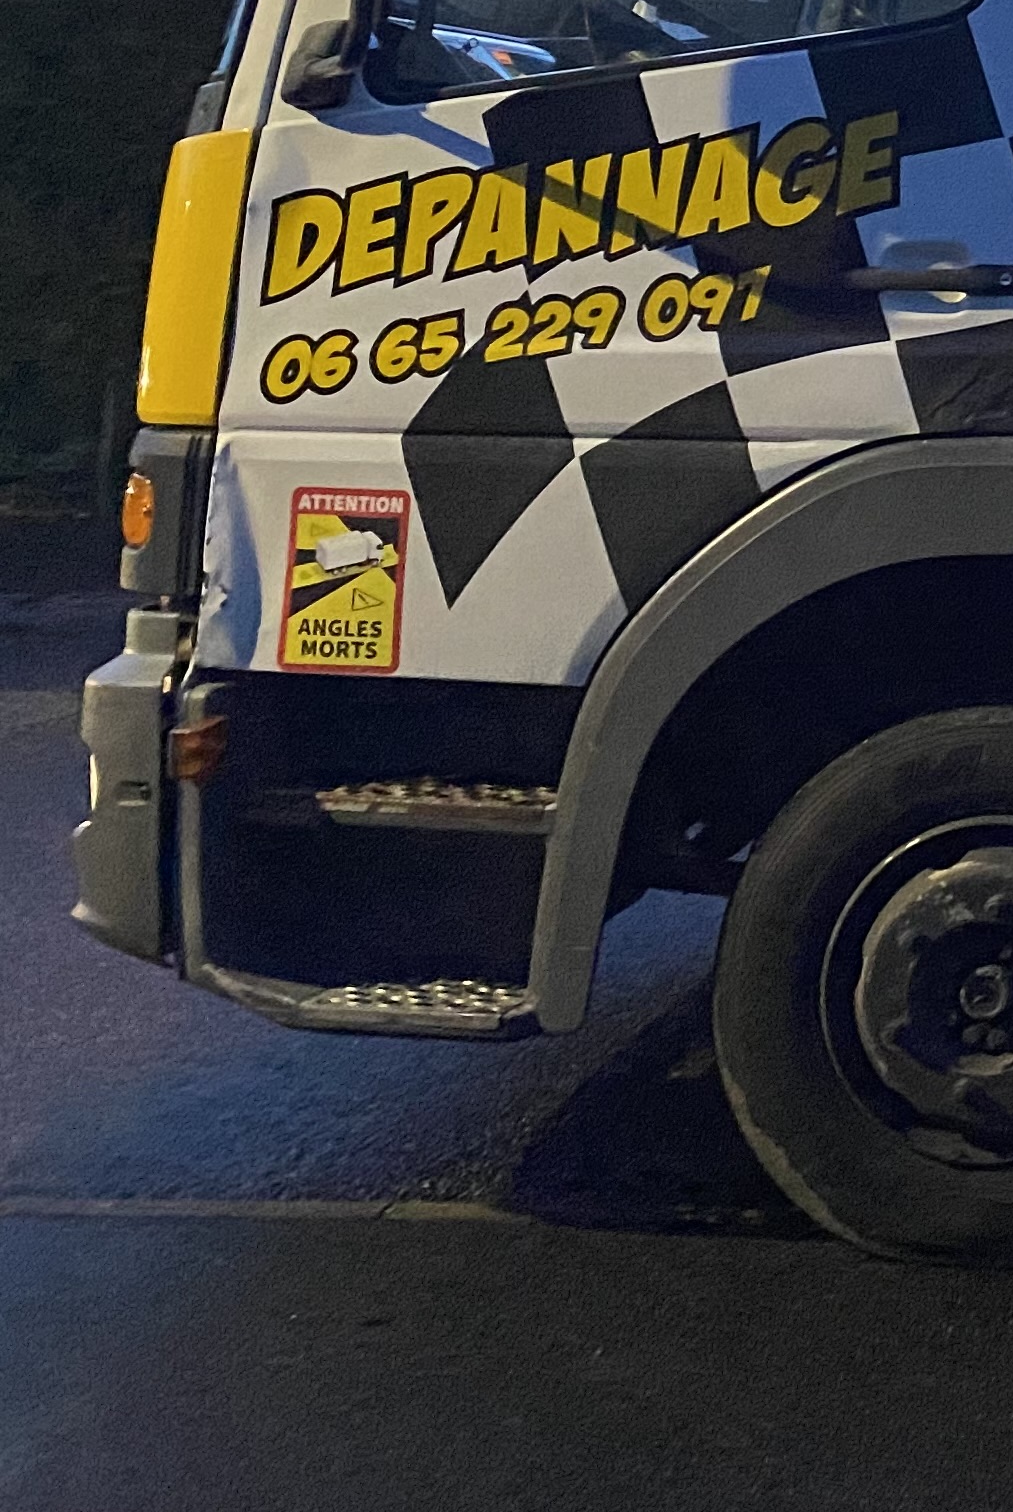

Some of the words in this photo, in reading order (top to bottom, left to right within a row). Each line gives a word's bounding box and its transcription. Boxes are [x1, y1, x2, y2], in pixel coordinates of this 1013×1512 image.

[261, 110, 900, 305] DEPANNAGE
[260, 331, 357, 404] 06
[370, 310, 465, 383] 65
[480, 287, 625, 364] 229
[638, 265, 772, 343] 097
[299, 494, 404, 513] ATTENTION
[299, 619, 382, 639] ANGLES
[301, 640, 378, 660] MORTS
